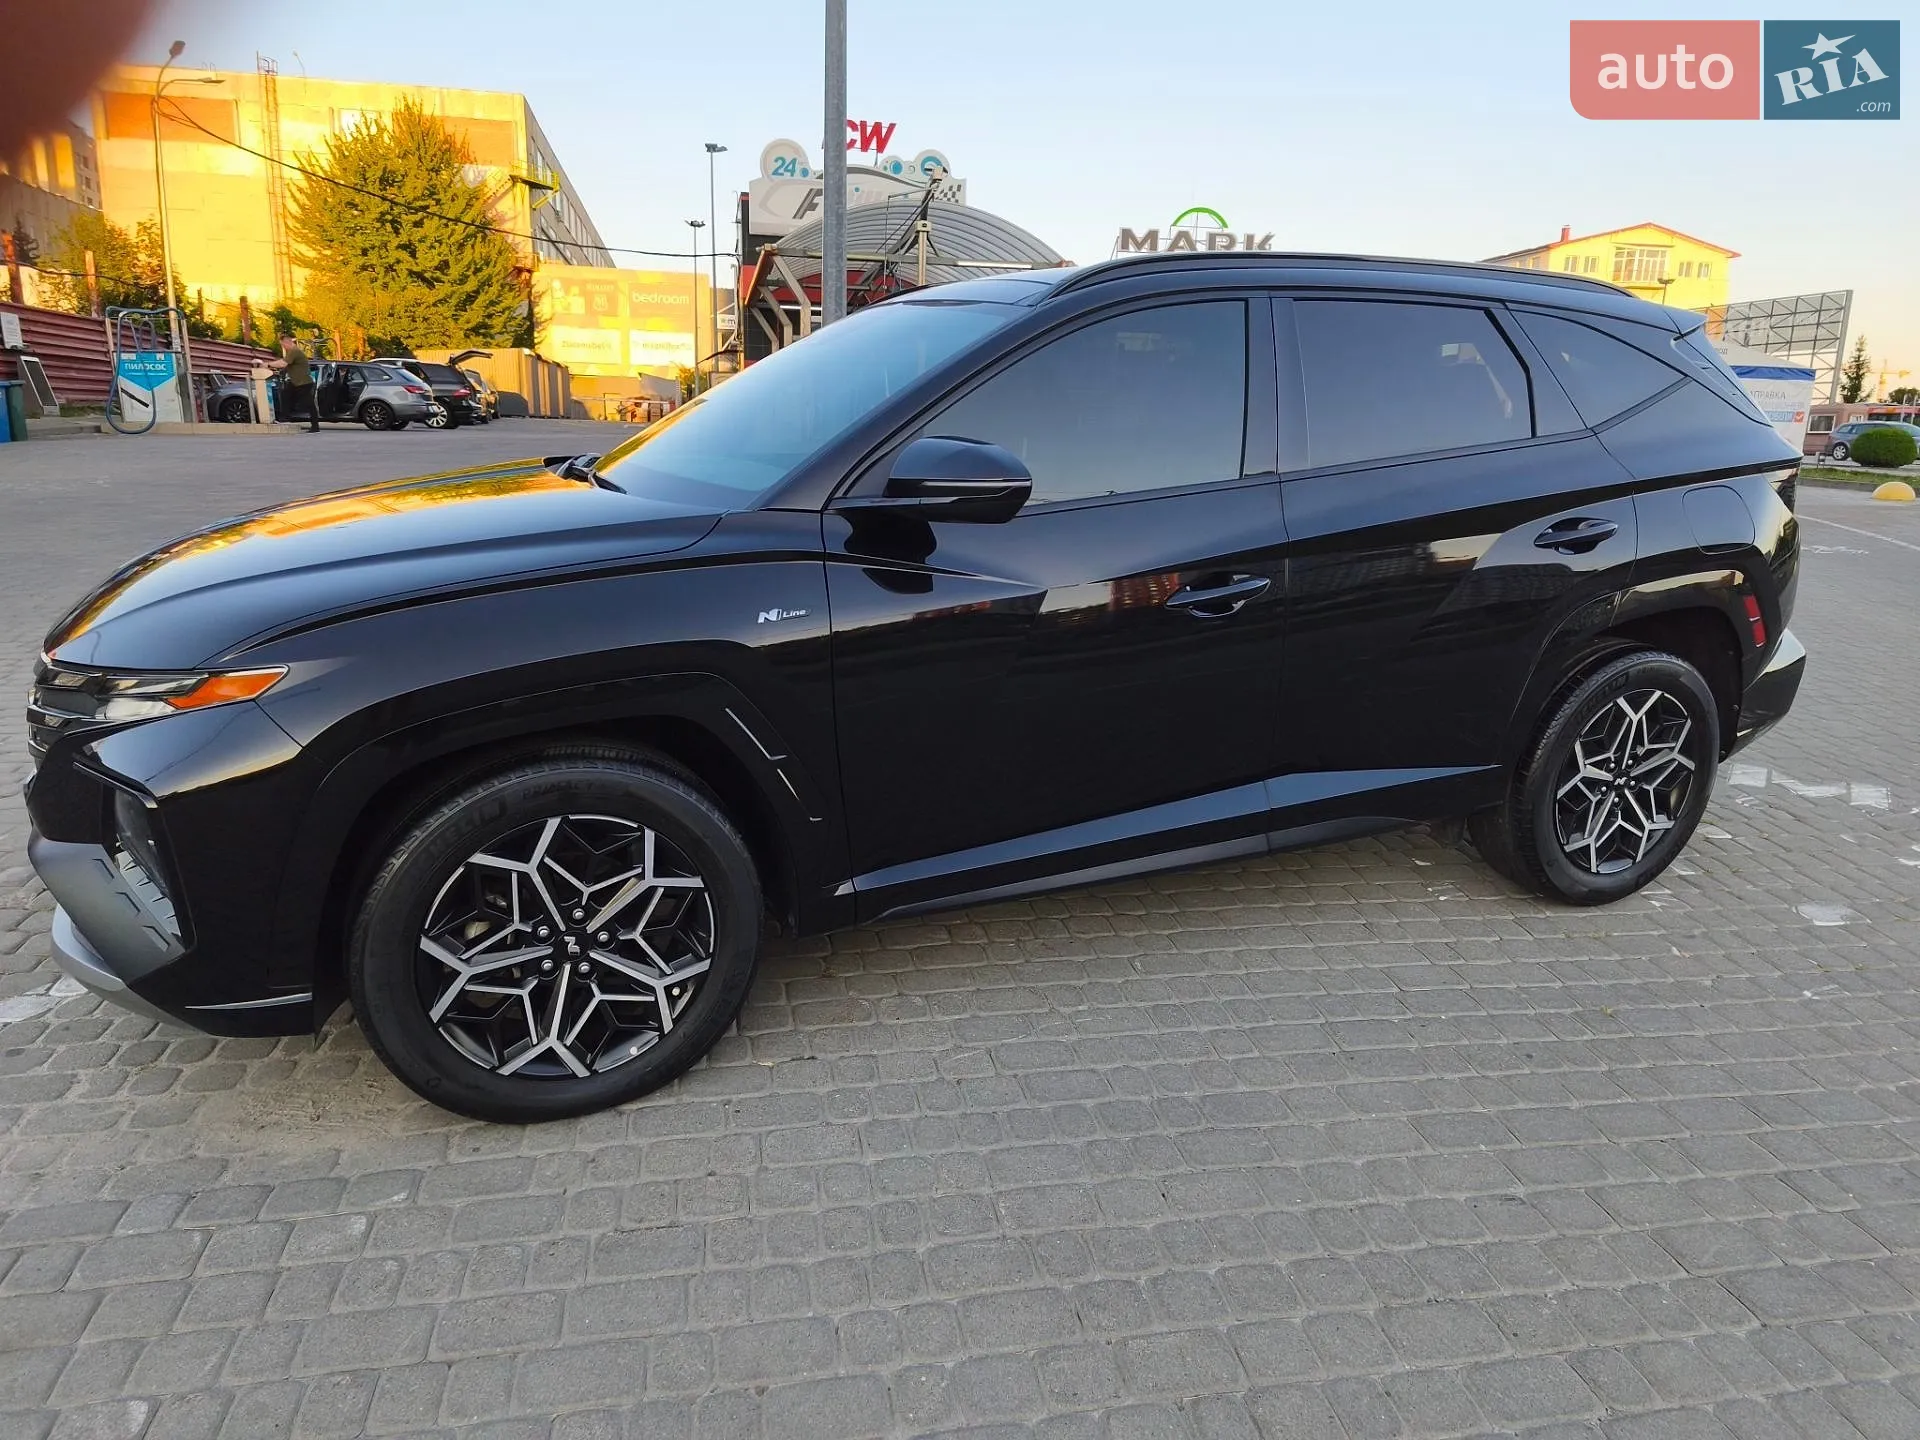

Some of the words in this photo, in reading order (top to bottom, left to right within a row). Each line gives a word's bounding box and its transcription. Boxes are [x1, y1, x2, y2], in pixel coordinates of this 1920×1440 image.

[846, 119, 896, 154] CW
[772, 156, 798, 177] 24
[632, 291, 690, 305] bedroom
[1750, 390, 1786, 400] ПРАВКА
